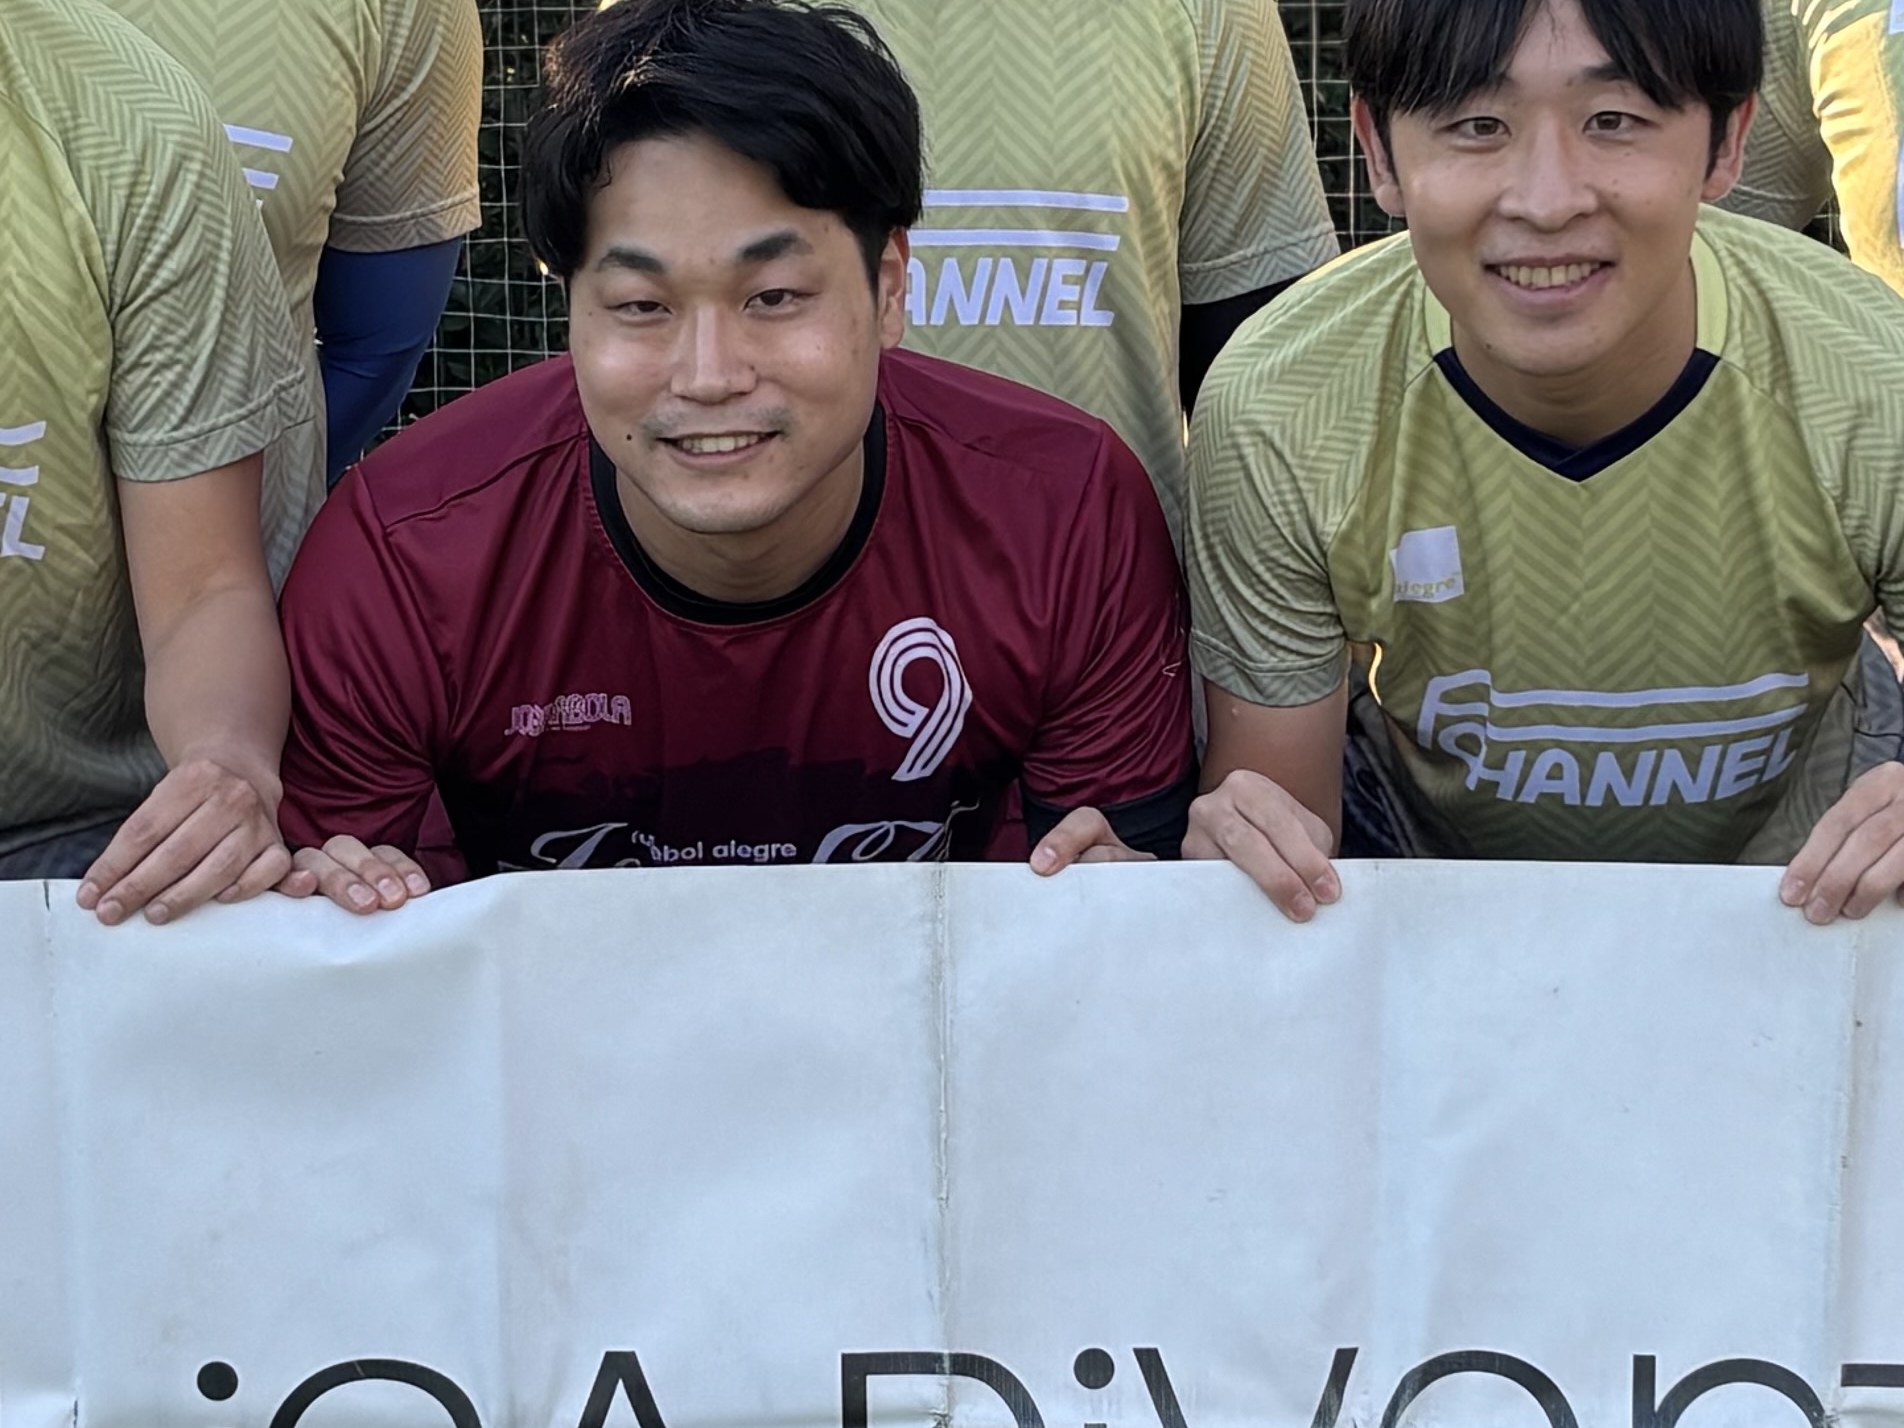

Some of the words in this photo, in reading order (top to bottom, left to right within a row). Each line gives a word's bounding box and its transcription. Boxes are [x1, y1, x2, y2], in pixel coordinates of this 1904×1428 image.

[899, 256, 1115, 327] ANNEL
[868, 616, 974, 782] 9
[712, 839, 798, 863] alegre
